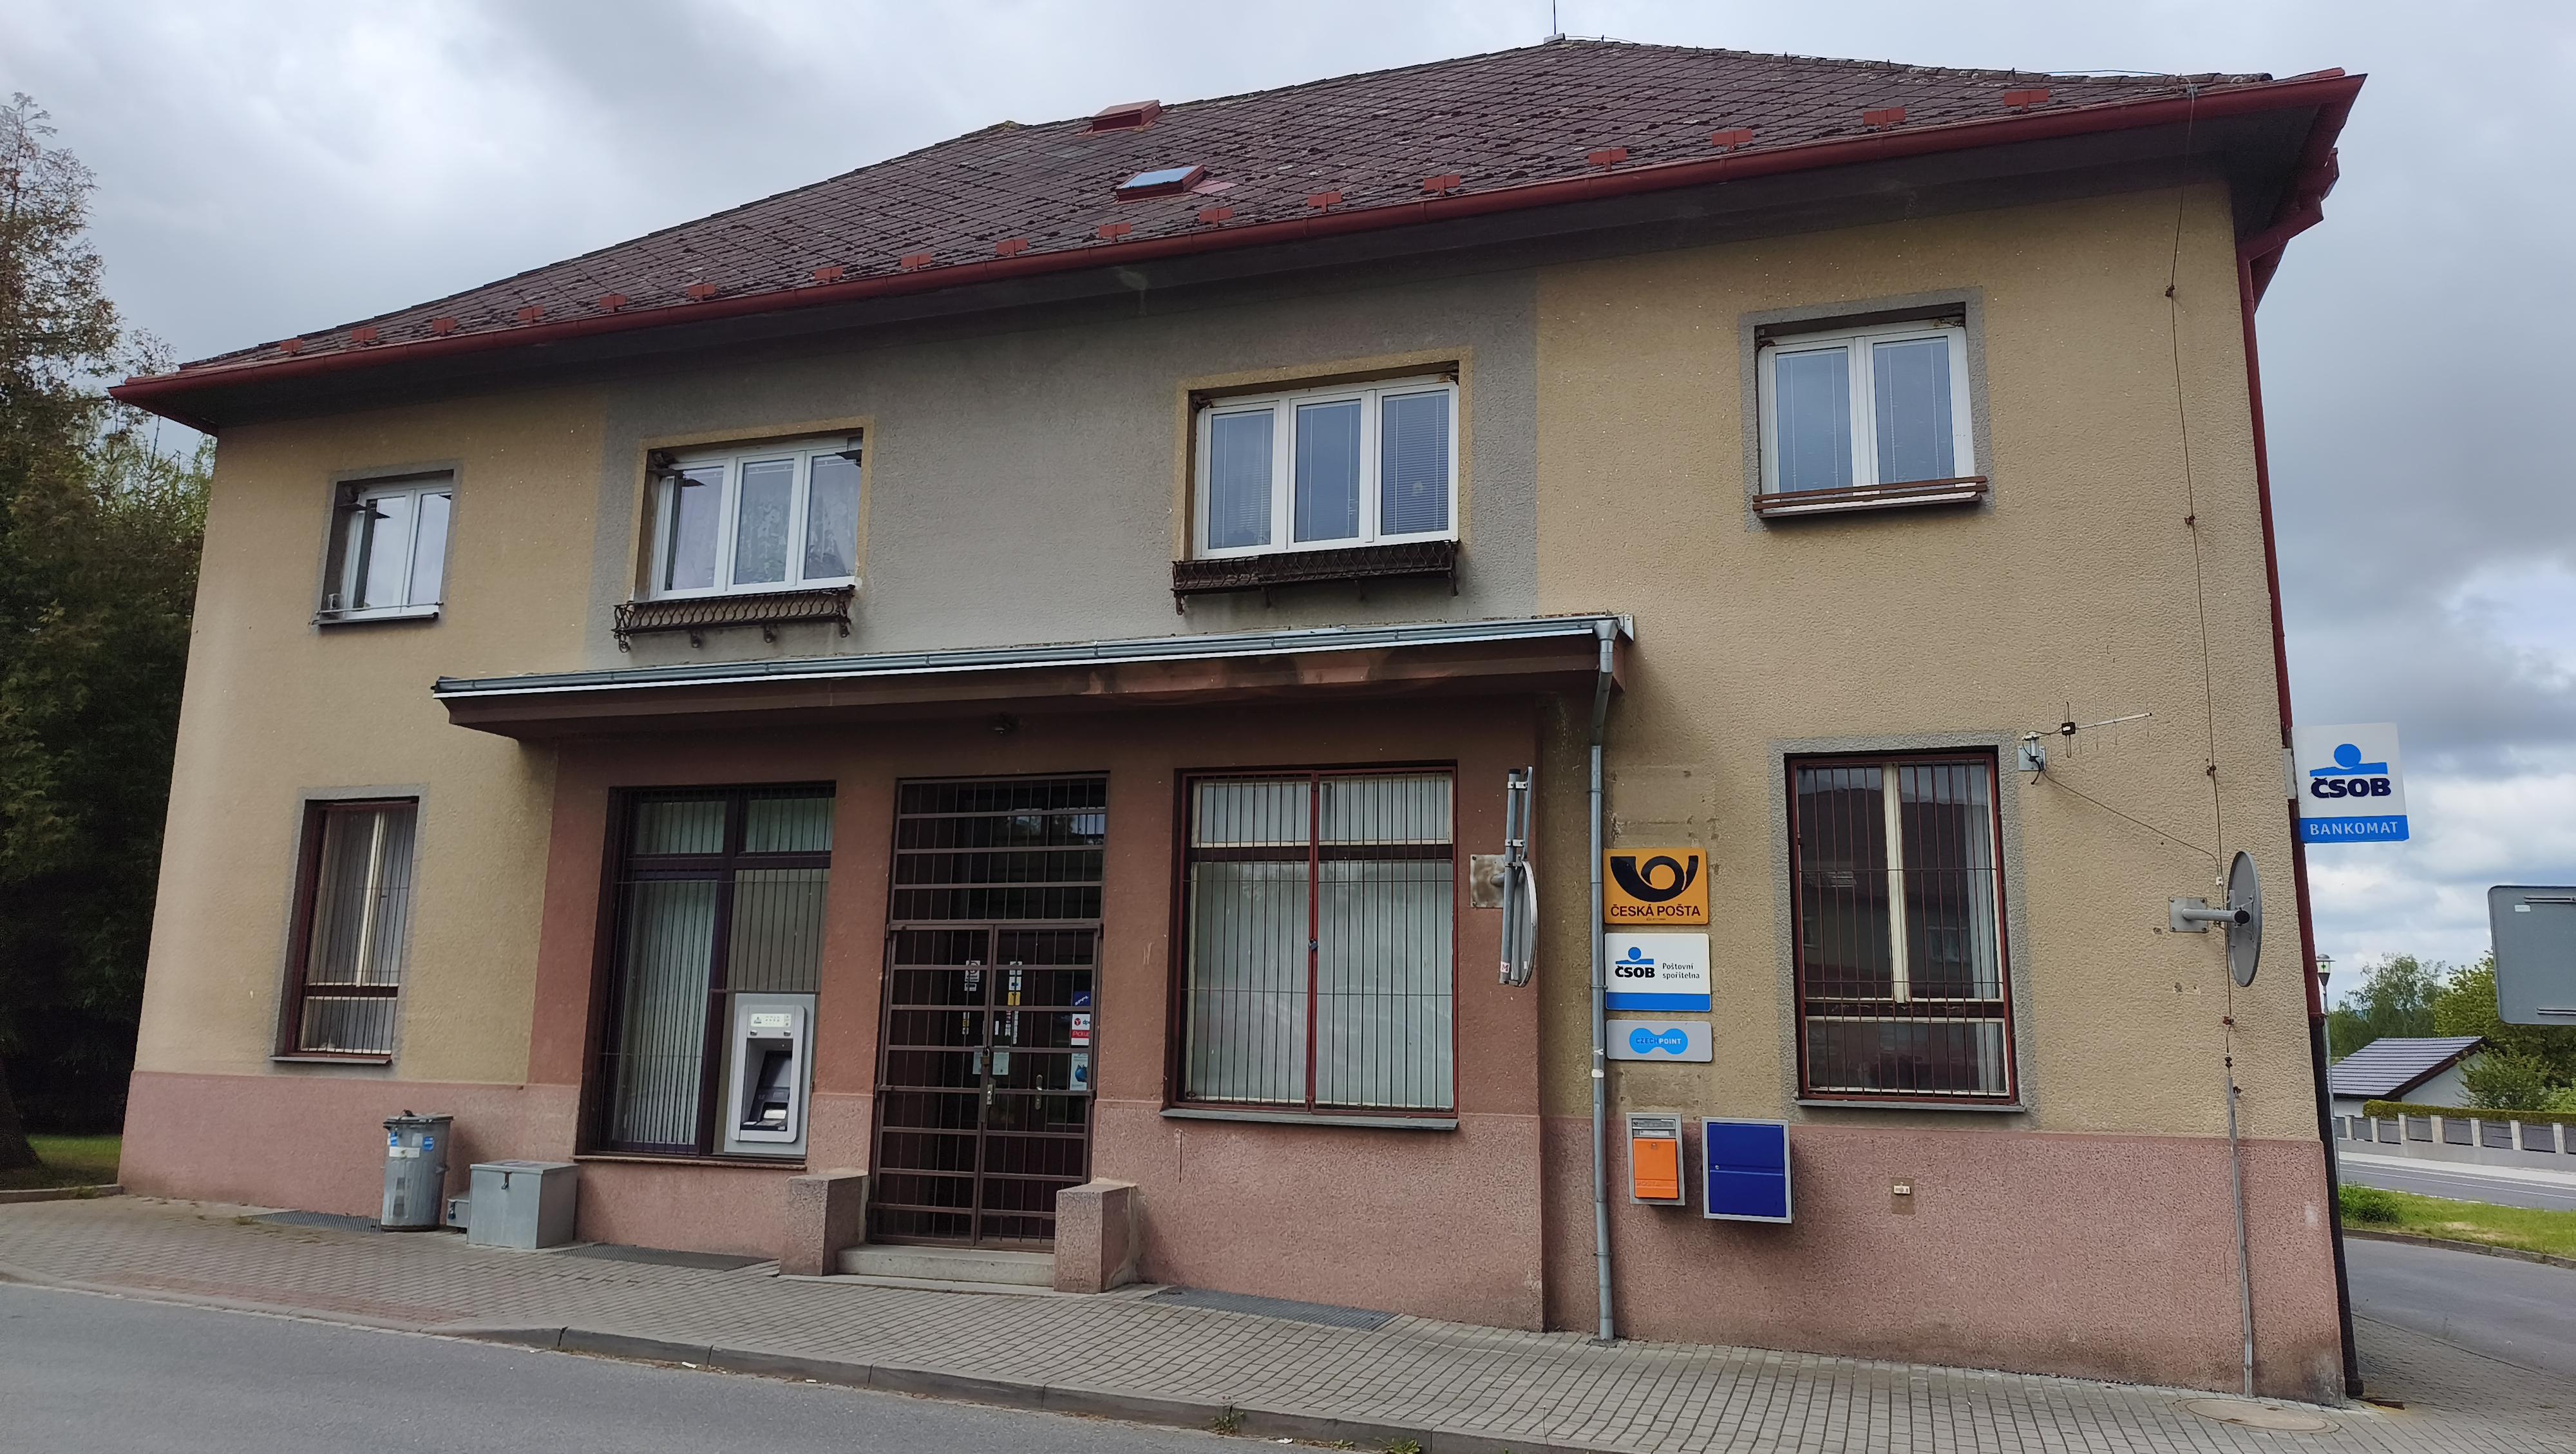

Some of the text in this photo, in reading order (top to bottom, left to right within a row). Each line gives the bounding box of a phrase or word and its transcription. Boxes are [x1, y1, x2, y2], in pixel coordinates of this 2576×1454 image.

[2311, 777, 2391, 798] ČSOB
[2309, 822, 2398, 835] BANKOMAT
[1611, 903, 1701, 916] ČESKÁ POŠTA
[1615, 965, 1655, 978] ČSOB
